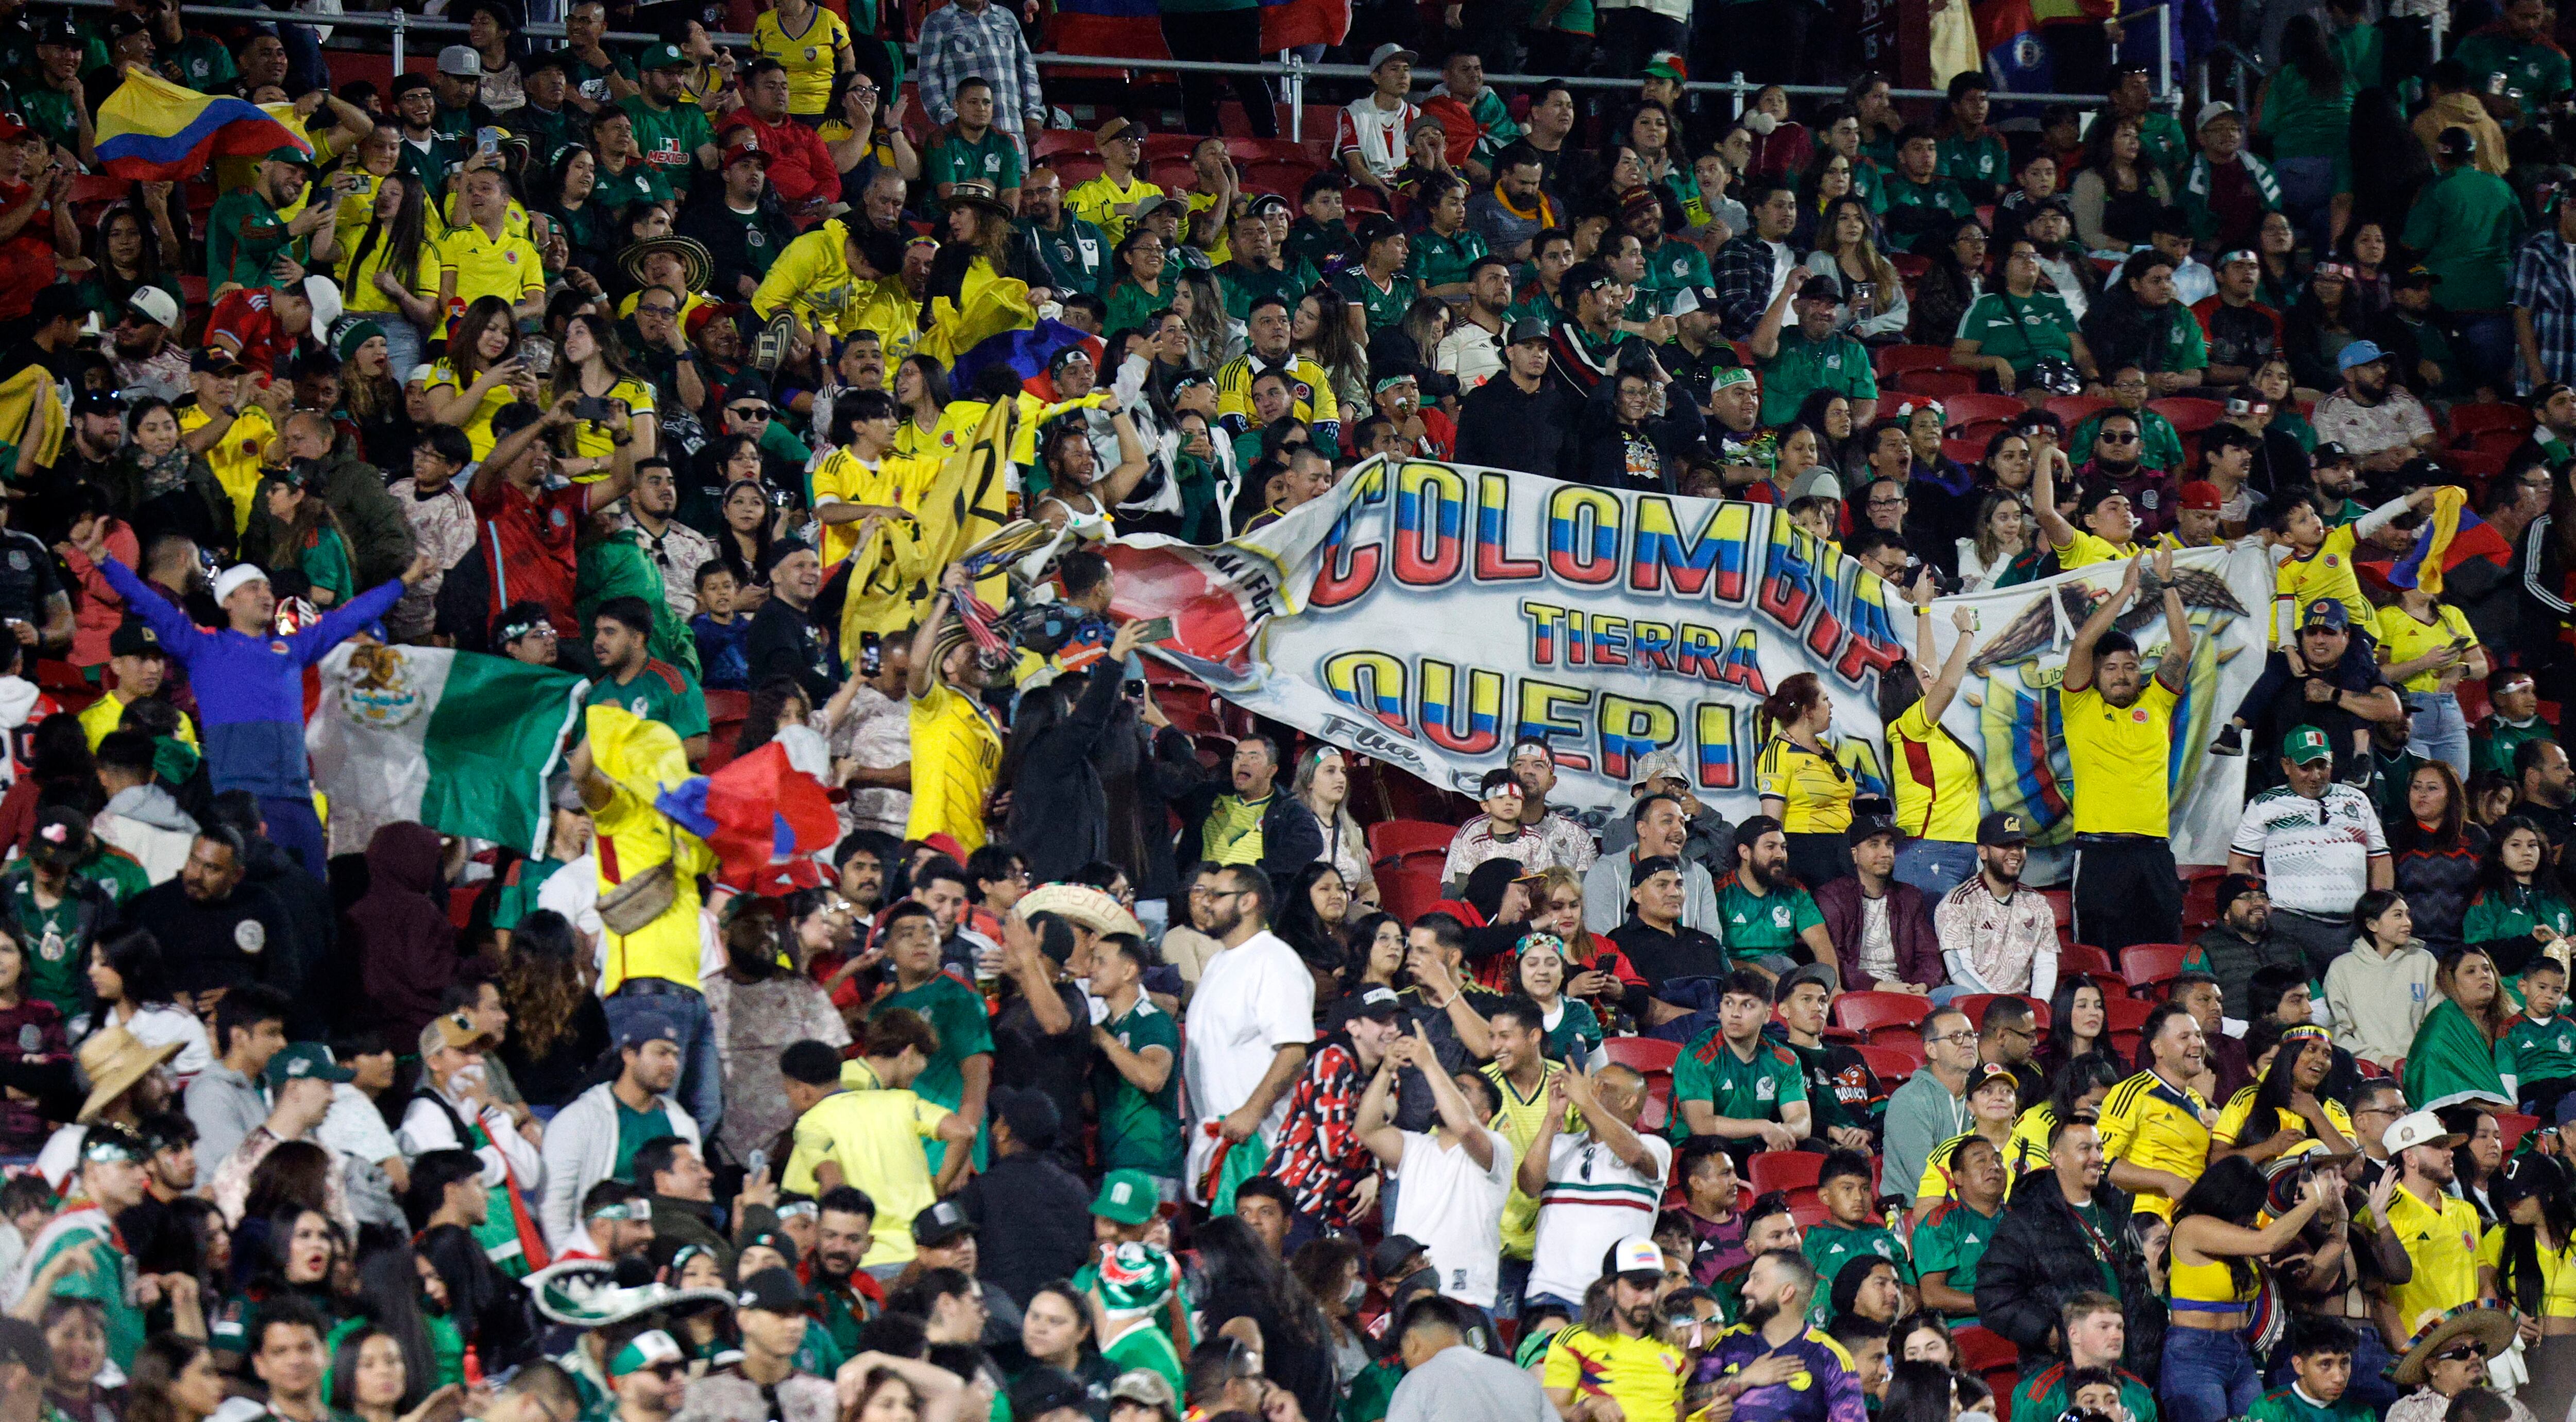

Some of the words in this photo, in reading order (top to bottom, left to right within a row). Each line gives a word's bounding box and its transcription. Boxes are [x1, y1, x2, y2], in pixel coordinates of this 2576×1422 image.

[647, 149, 689, 165] MEXICO
[1309, 458, 1906, 683] COLOMBIA
[1524, 602, 1770, 697] TIERRA
[980, 738, 997, 769] 10
[1325, 650, 1888, 797] QUERIA
[2004, 816, 2020, 832] Cal
